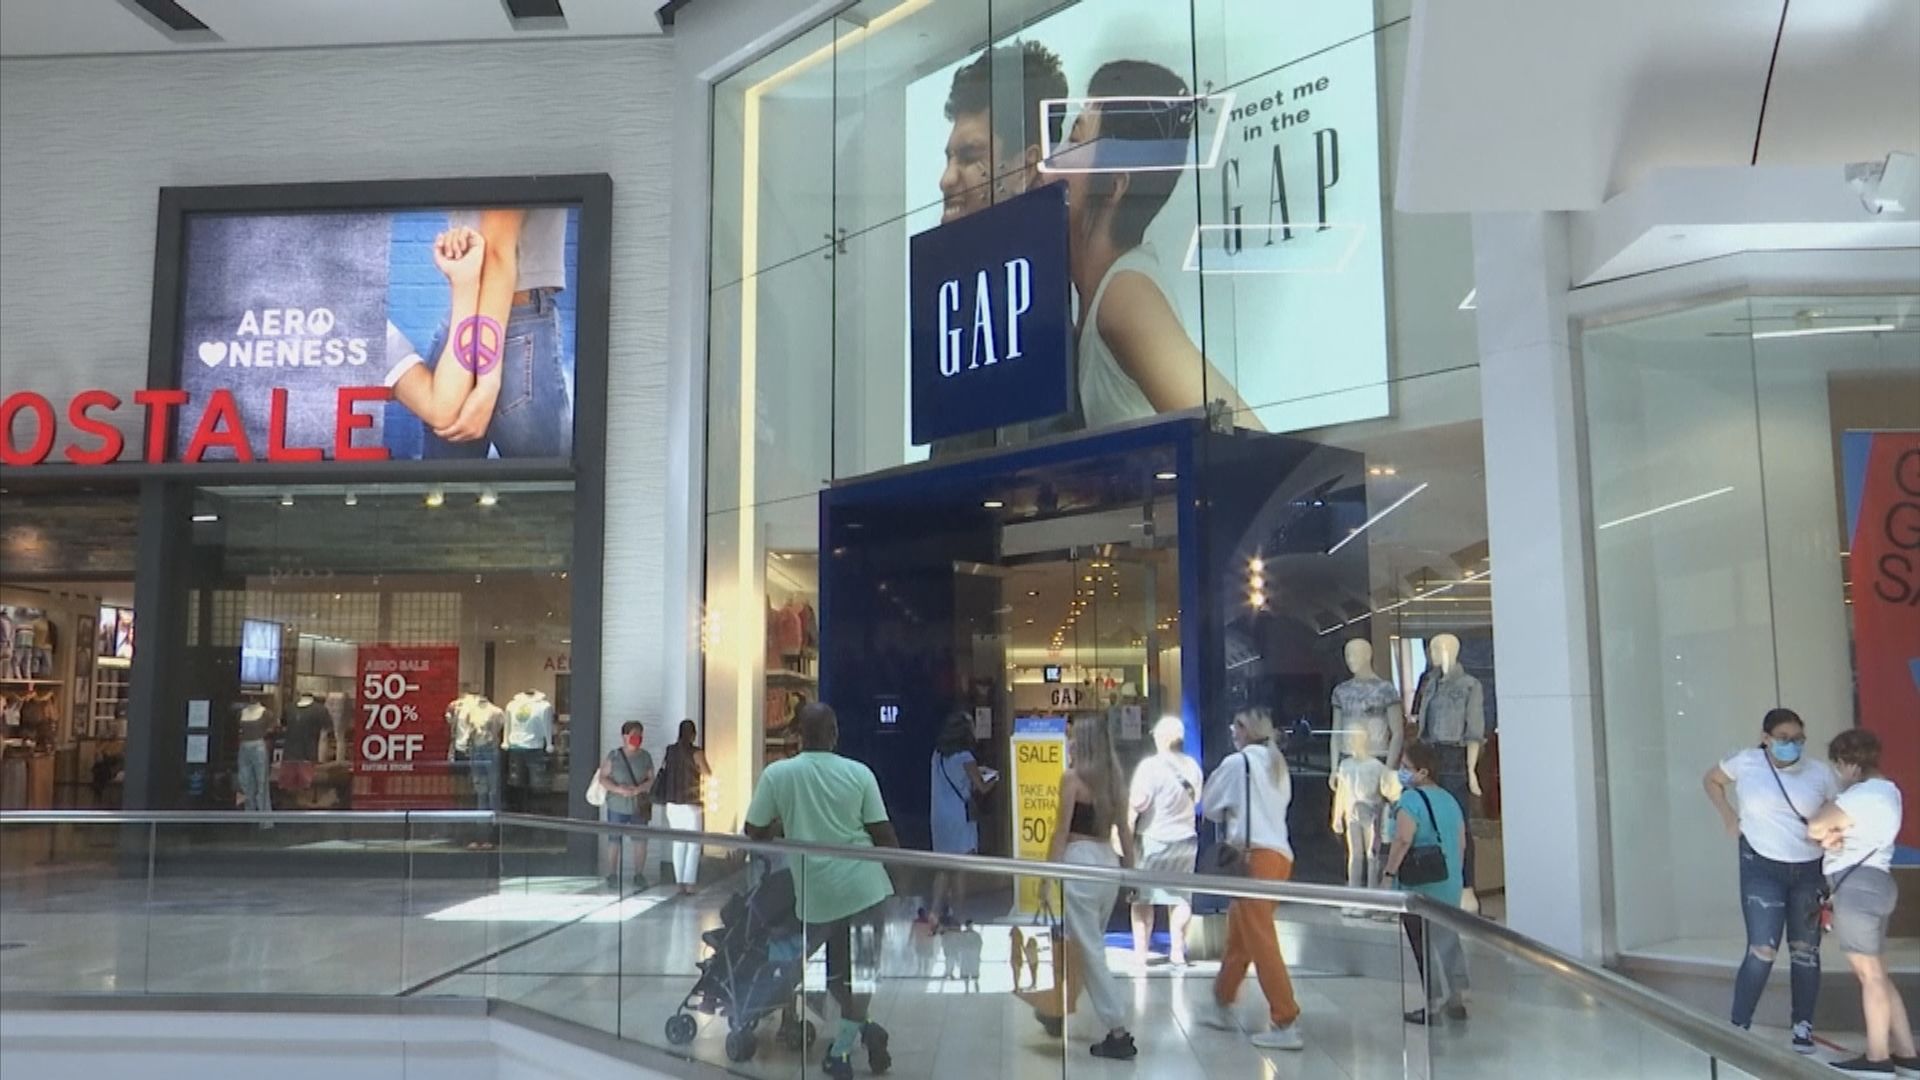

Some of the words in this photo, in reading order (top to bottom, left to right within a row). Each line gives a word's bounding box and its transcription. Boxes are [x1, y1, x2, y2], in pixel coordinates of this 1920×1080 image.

[1293, 76, 1330, 100] me
[1244, 125, 1262, 142] in
[1271, 108, 1310, 132] the
[1222, 127, 1340, 256] GAP
[938, 257, 1031, 377] GAP
[1051, 688, 1083, 706] GAP
[362, 704, 419, 731] 70%
[880, 705, 899, 724] GAP
[361, 734, 424, 761] OFF
[1018, 745, 1059, 763] SALE
[1019, 784, 1044, 797] TAKE
[1023, 798, 1057, 811] EXTRA
